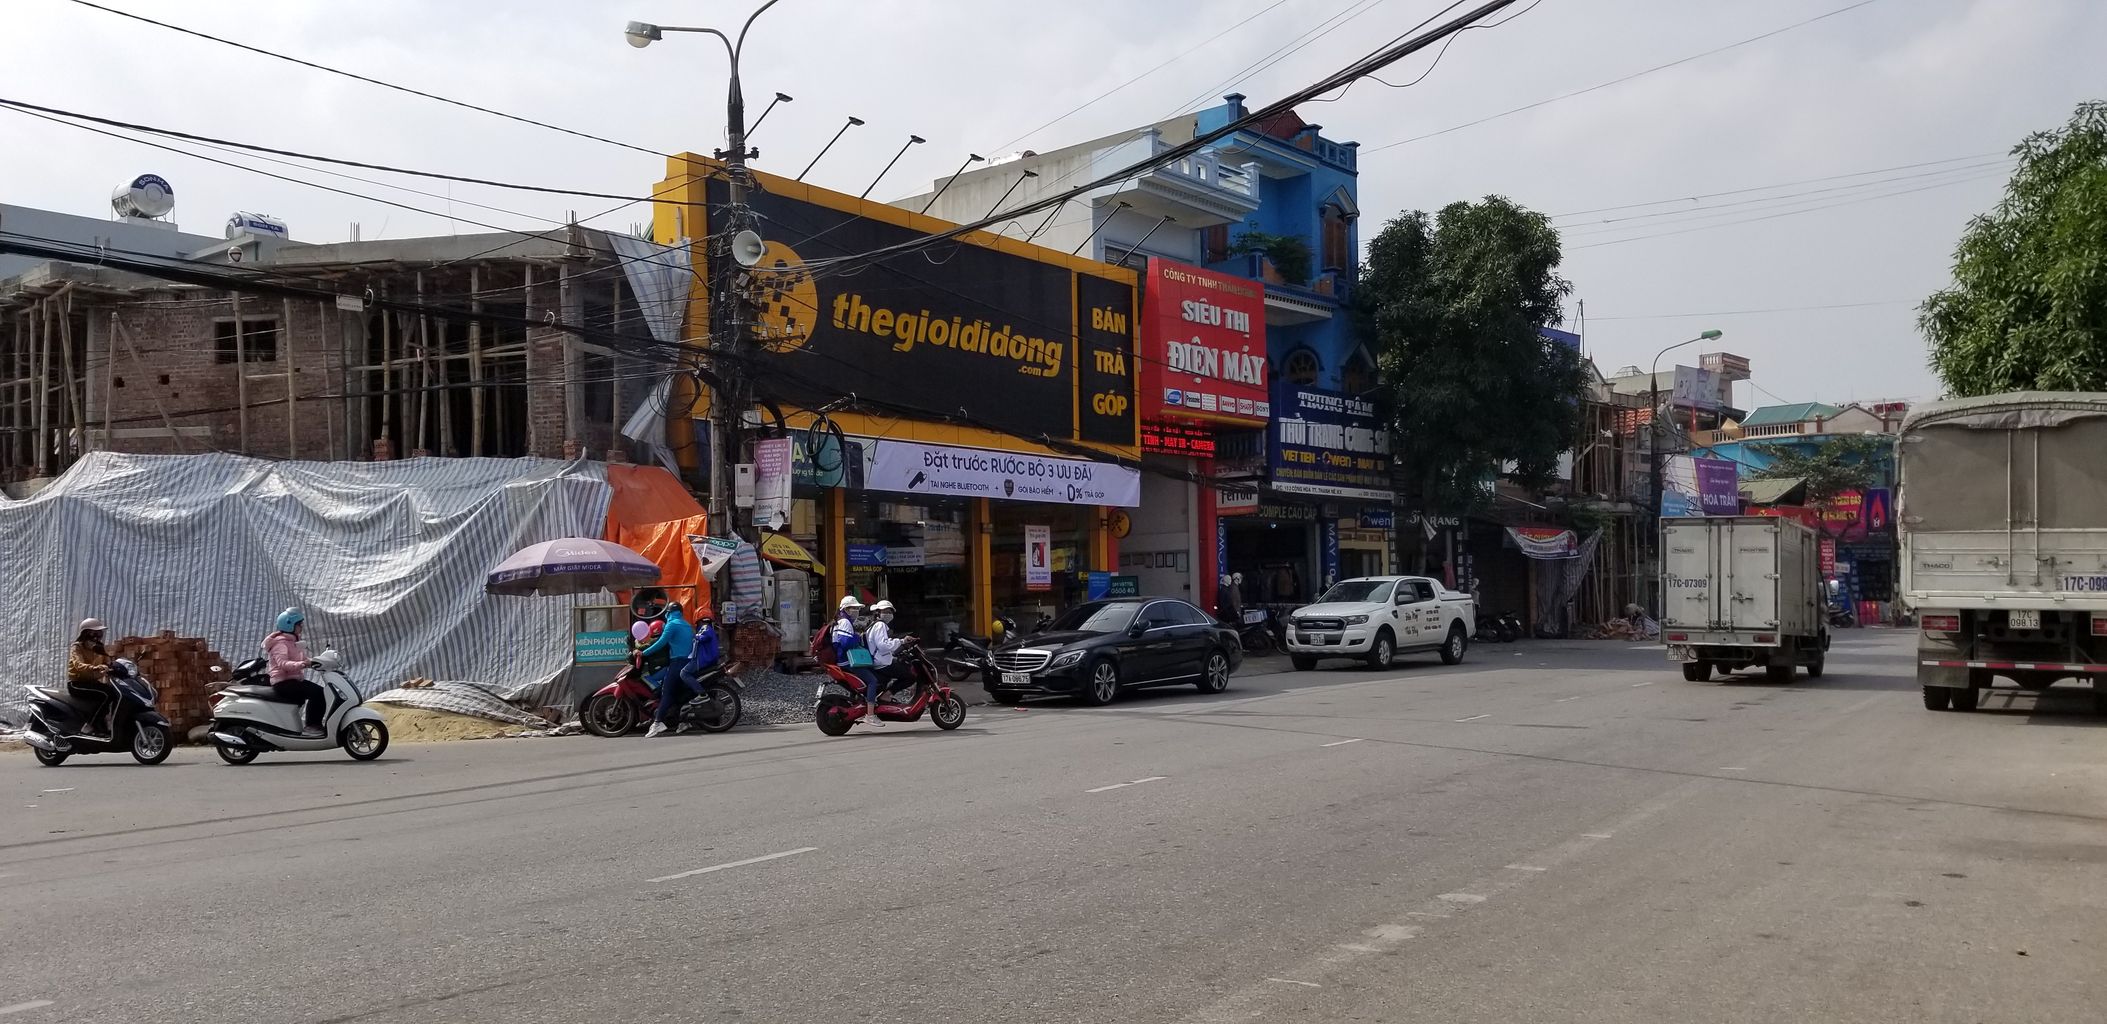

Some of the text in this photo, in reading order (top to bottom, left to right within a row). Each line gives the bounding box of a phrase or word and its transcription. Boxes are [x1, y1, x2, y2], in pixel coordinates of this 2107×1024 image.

[1163, 267, 1186, 282] CÔNG
[1187, 274, 1197, 285] TY
[1198, 276, 1218, 290] TNHH
[1091, 306, 1126, 336] BÁN
[1181, 298, 1250, 339] SIÊU THỊ
[832, 292, 1064, 378] thegioididong
[1018, 364, 1042, 376] .com
[1093, 347, 1126, 377] TRẢ
[1167, 336, 1265, 386] ĐIỆN MÁY
[1092, 389, 1128, 417] GÓP
[923, 451, 1092, 482] Đặt trước RƯỚC BỘ 3 ƯU ĐÃI
[940, 481, 957, 490] NGHE
[957, 483, 990, 492] BLUETOOTH
[1066, 483, 1083, 503] 0%
[1703, 493, 1719, 506] HOA
[1327, 523, 1337, 557] MAY
[1923, 562, 1950, 570] THACO
[1668, 579, 1708, 589] 17C-07309
[2010, 618, 2039, 628] 098.13
[2016, 610, 2033, 619] 17C
[593, 636, 606, 646] PHÍ
